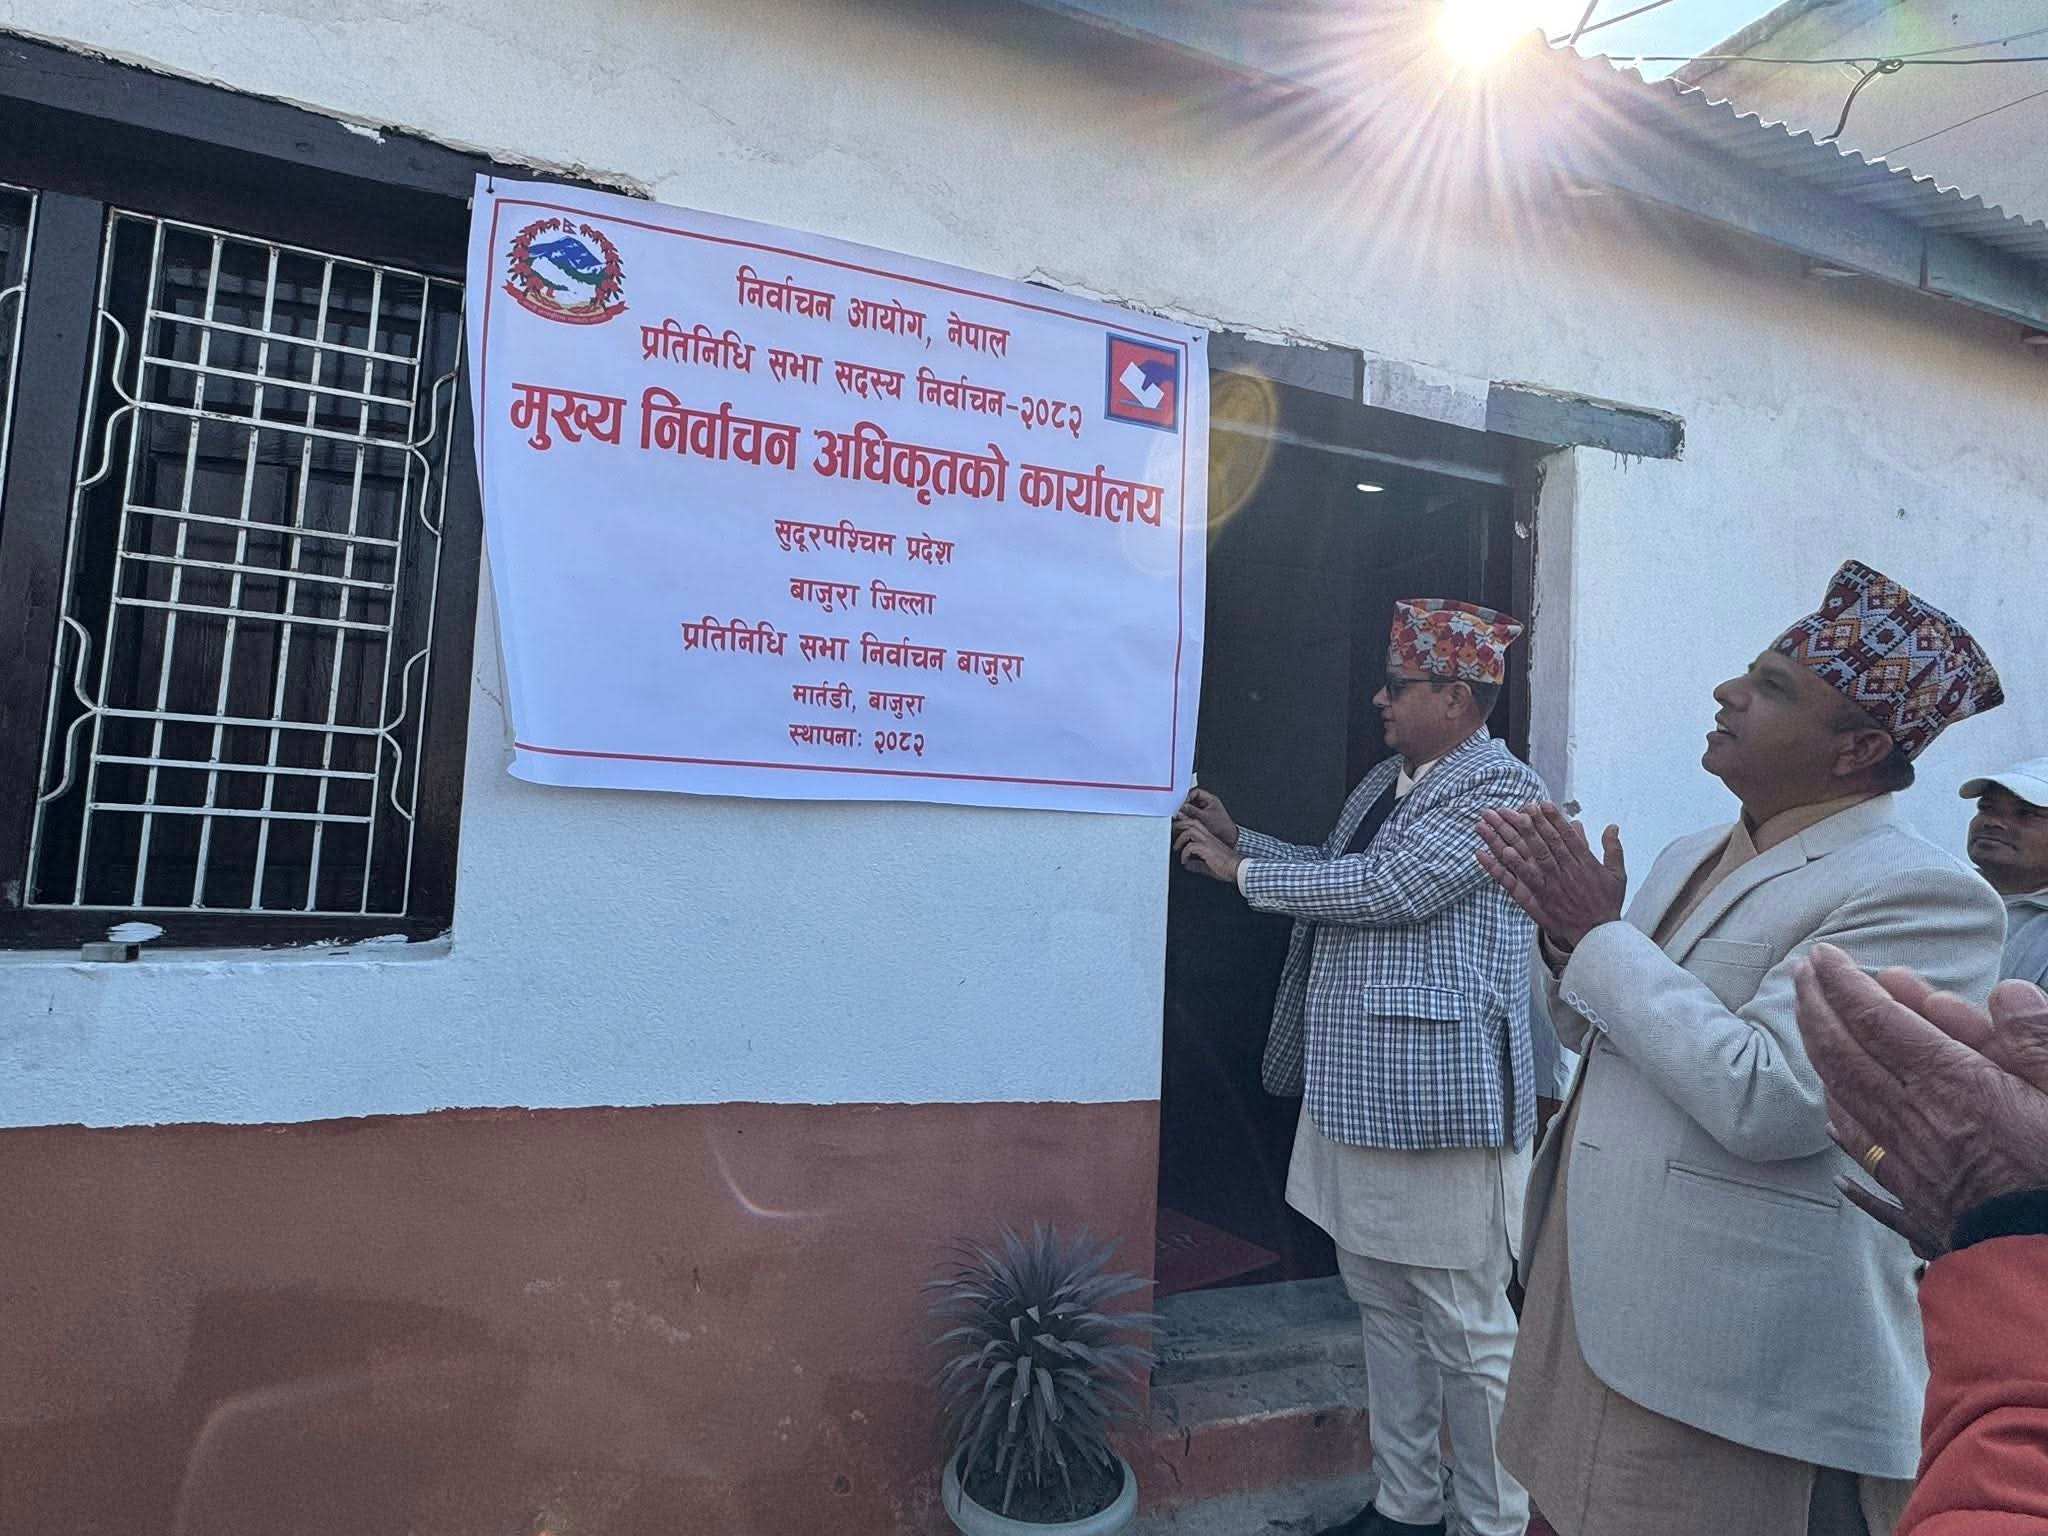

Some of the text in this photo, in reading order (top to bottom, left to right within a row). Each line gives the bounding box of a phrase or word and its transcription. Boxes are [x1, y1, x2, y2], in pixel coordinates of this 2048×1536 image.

[736, 265, 1010, 357] निर्वाचन आयोग, नेपाल
[641, 319, 756, 373] प्रतिनिधि
[768, 349, 823, 385] सभा
[835, 361, 905, 401] सदस्य
[510, 382, 1164, 527] मुख्य निर्वाचन अधिकृतको कार्यालय
[774, 520, 955, 565] सुदूरपश्चिम प्रदेश
[790, 578, 936, 616] बाजुरा जिल्ला
[682, 616, 1024, 685] प्रतिनिधि सभा निर्वाचन बाजुरा
[868, 691, 925, 719] बाजुरा
[874, 731, 924, 757] २०८२
